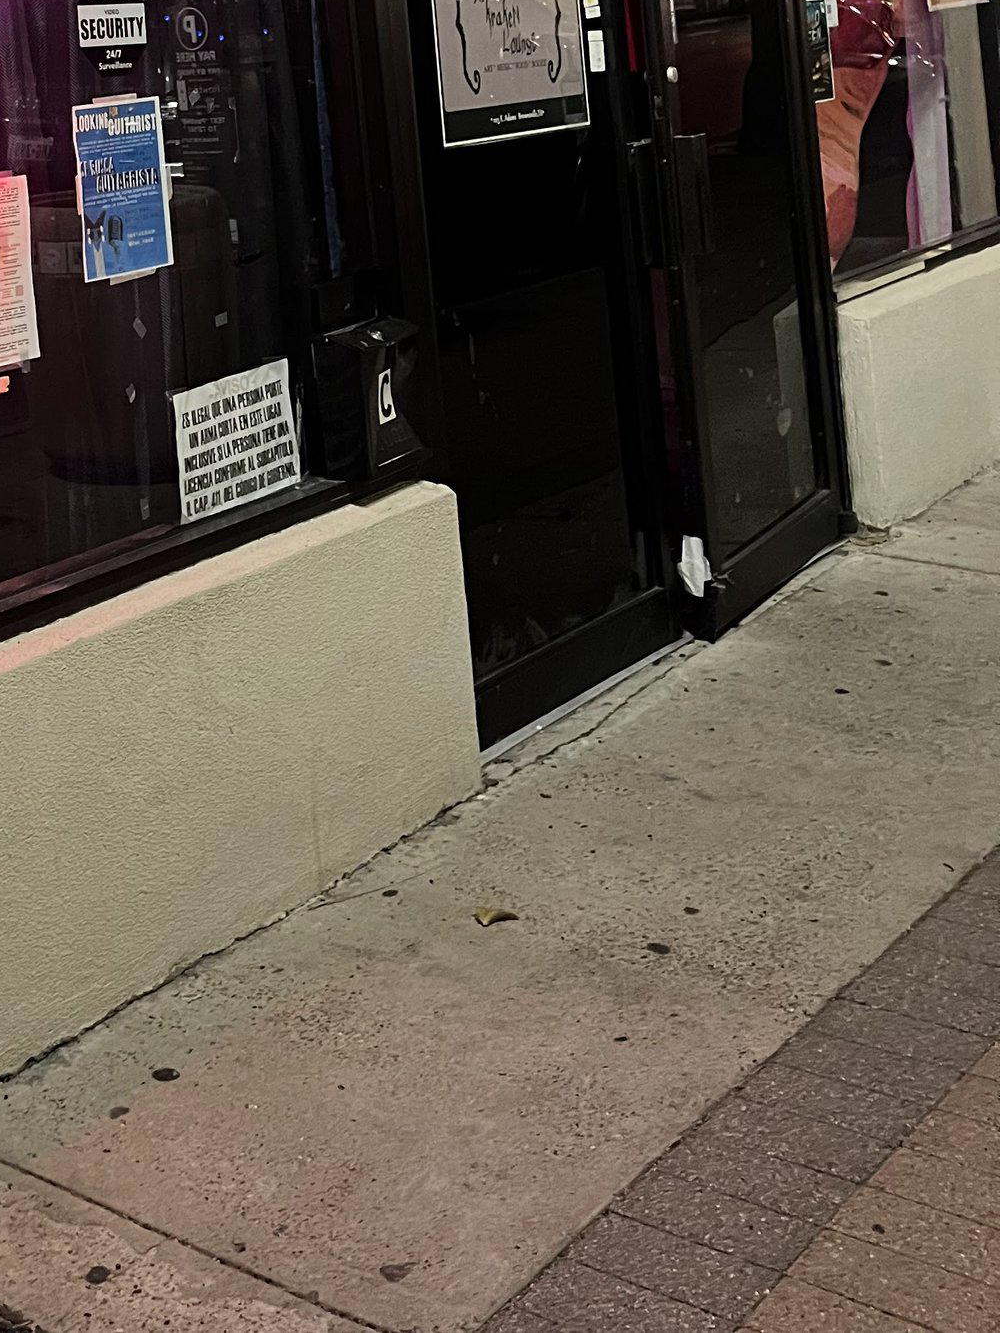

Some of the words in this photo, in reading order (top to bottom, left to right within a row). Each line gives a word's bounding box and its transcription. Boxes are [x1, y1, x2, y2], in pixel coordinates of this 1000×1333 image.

[80, 17, 144, 41] SECURITY
[106, 50, 122, 59] 24/7
[108, 113, 157, 137] GUITARIST
[182, 412, 191, 429] ES
[211, 400, 222, 419] QUE
[222, 396, 236, 415] UNA
[237, 387, 265, 409] PERSONA
[380, 373, 392, 418] C
[189, 432, 199, 449] UN
[240, 414, 249, 430] EN
[250, 408, 263, 427] ESTE
[223, 442, 232, 460] LA
[232, 432, 262, 457] PERSONA
